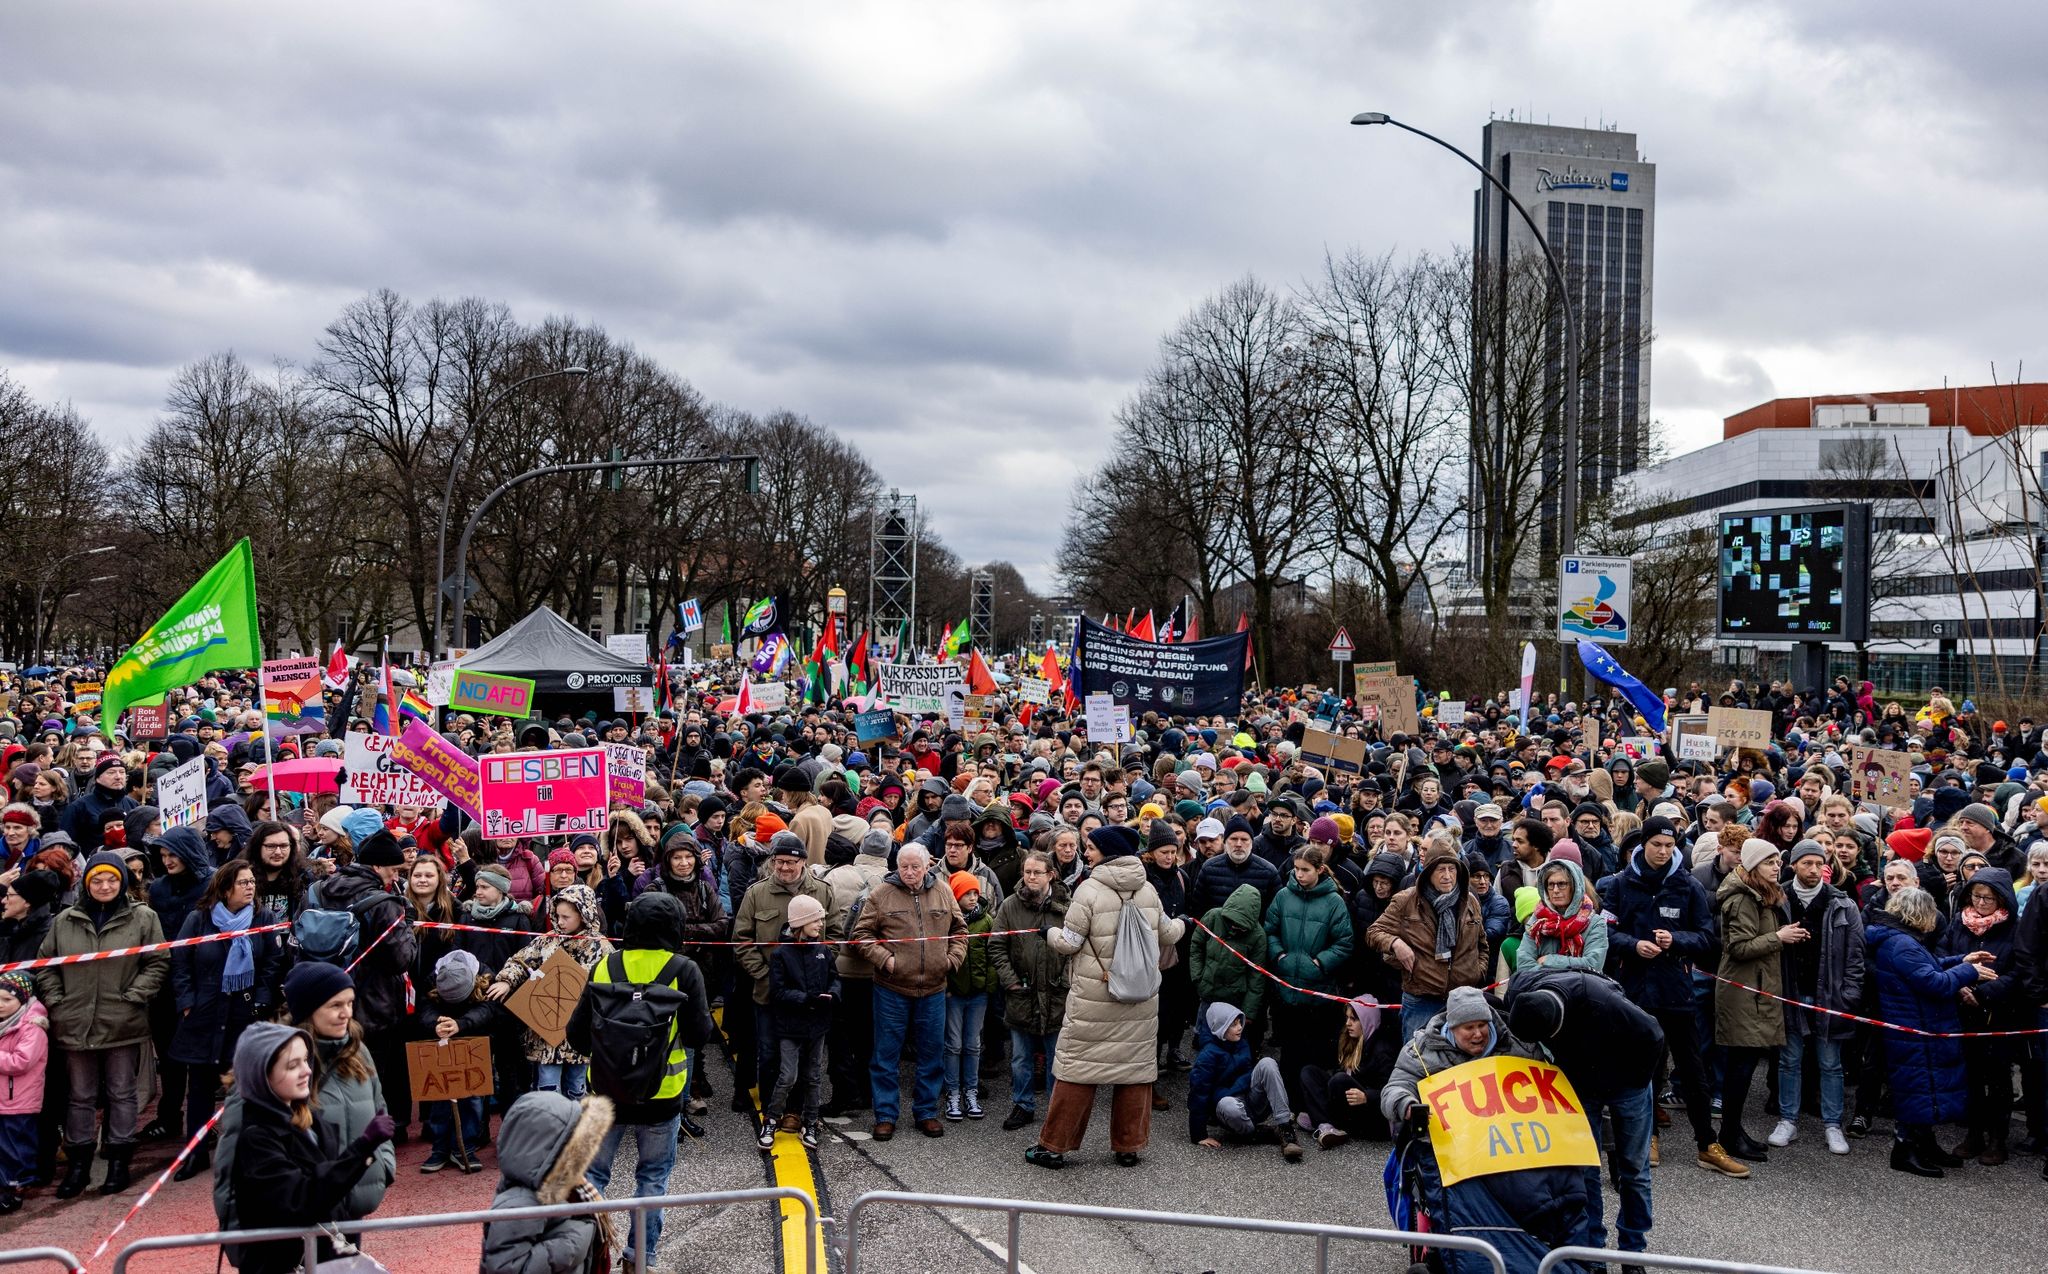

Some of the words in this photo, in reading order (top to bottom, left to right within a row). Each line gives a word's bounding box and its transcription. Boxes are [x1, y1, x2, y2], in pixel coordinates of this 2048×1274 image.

[1536, 164, 1609, 193] Radisson
[1569, 561, 1576, 572] P
[1085, 641, 1154, 658] GEMEINSAM
[1156, 651, 1195, 661] GEGEN
[1085, 651, 1152, 669] RASSISMUS,
[1154, 661, 1228, 671] AUFRÜSTUNG
[263, 661, 317, 673] Nationalität
[880, 664, 900, 679] NUR
[903, 665, 961, 680] RASSISTEN
[1085, 660, 1108, 670] UND
[1109, 664, 1193, 681] SOZIALABBAU!
[272, 672, 311, 683] MENSCH
[587, 674, 642, 684] PROTONES
[458, 680, 488, 701] NO
[487, 686, 526, 707] AFD
[882, 679, 928, 697] SUPPORTEN
[1686, 739, 1710, 747] Huck
[1718, 729, 1738, 739] FCK
[1740, 730, 1761, 740] AFD
[422, 736, 479, 784] Frauen
[487, 755, 599, 783] LESBEN
[391, 742, 445, 783] gegen
[445, 773, 481, 814] Rech
[537, 785, 553, 801] FÜR
[416, 1043, 485, 1070] FUCK
[421, 1067, 487, 1098] AFD
[1427, 1065, 1579, 1132] FUCK
[1488, 1121, 1552, 1158] AFD
